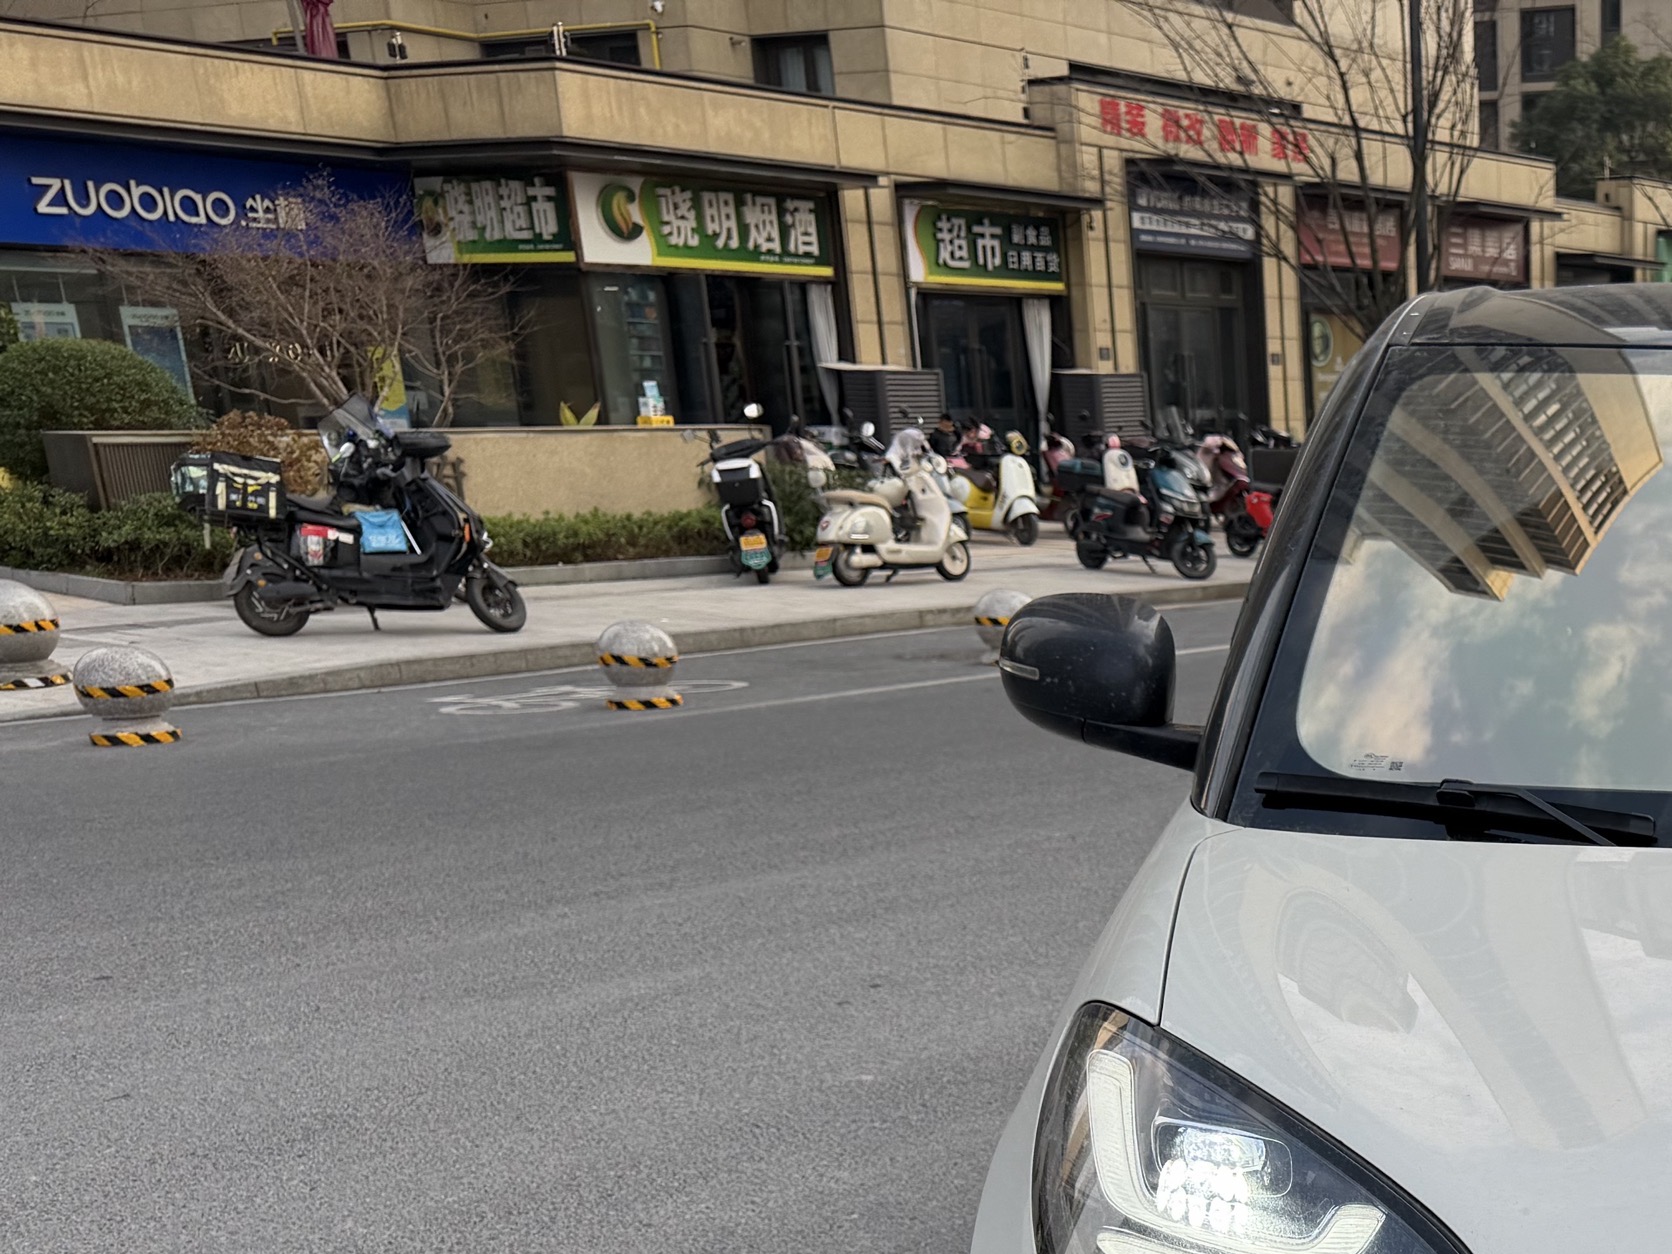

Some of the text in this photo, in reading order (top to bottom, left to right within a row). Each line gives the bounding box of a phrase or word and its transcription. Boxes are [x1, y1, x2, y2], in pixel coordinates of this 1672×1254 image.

[1099, 98, 1146, 137] 精装
[656, 186, 820, 257] 骁明烟酒
[1010, 224, 1052, 246] 副食品
[935, 213, 1003, 271] 超市
[1006, 251, 1060, 273] 日用百货
